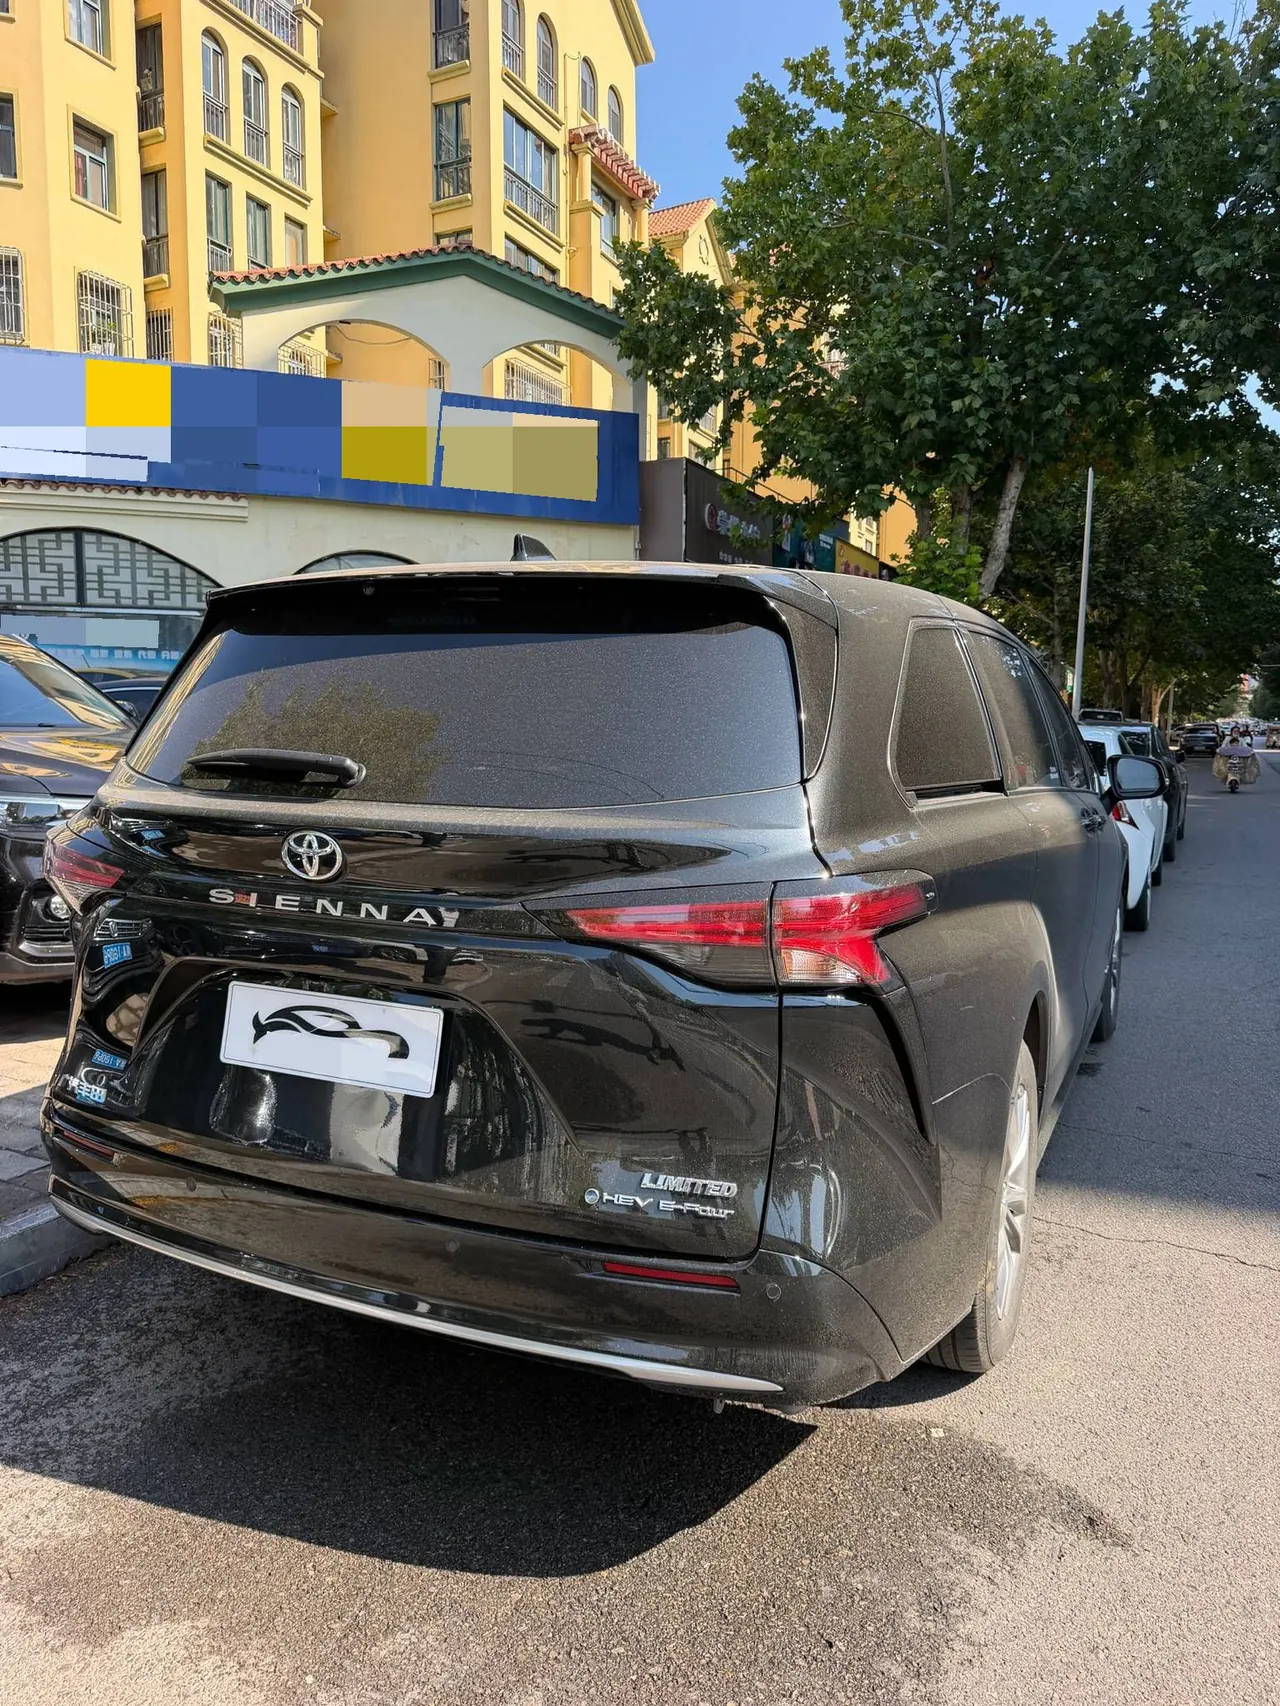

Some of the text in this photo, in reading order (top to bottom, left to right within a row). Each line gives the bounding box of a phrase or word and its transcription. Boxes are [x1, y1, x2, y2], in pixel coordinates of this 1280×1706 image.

[209, 888, 437, 926] SIENNA
[641, 1173, 738, 1197] LIMITED
[602, 1192, 653, 1207] HEV
